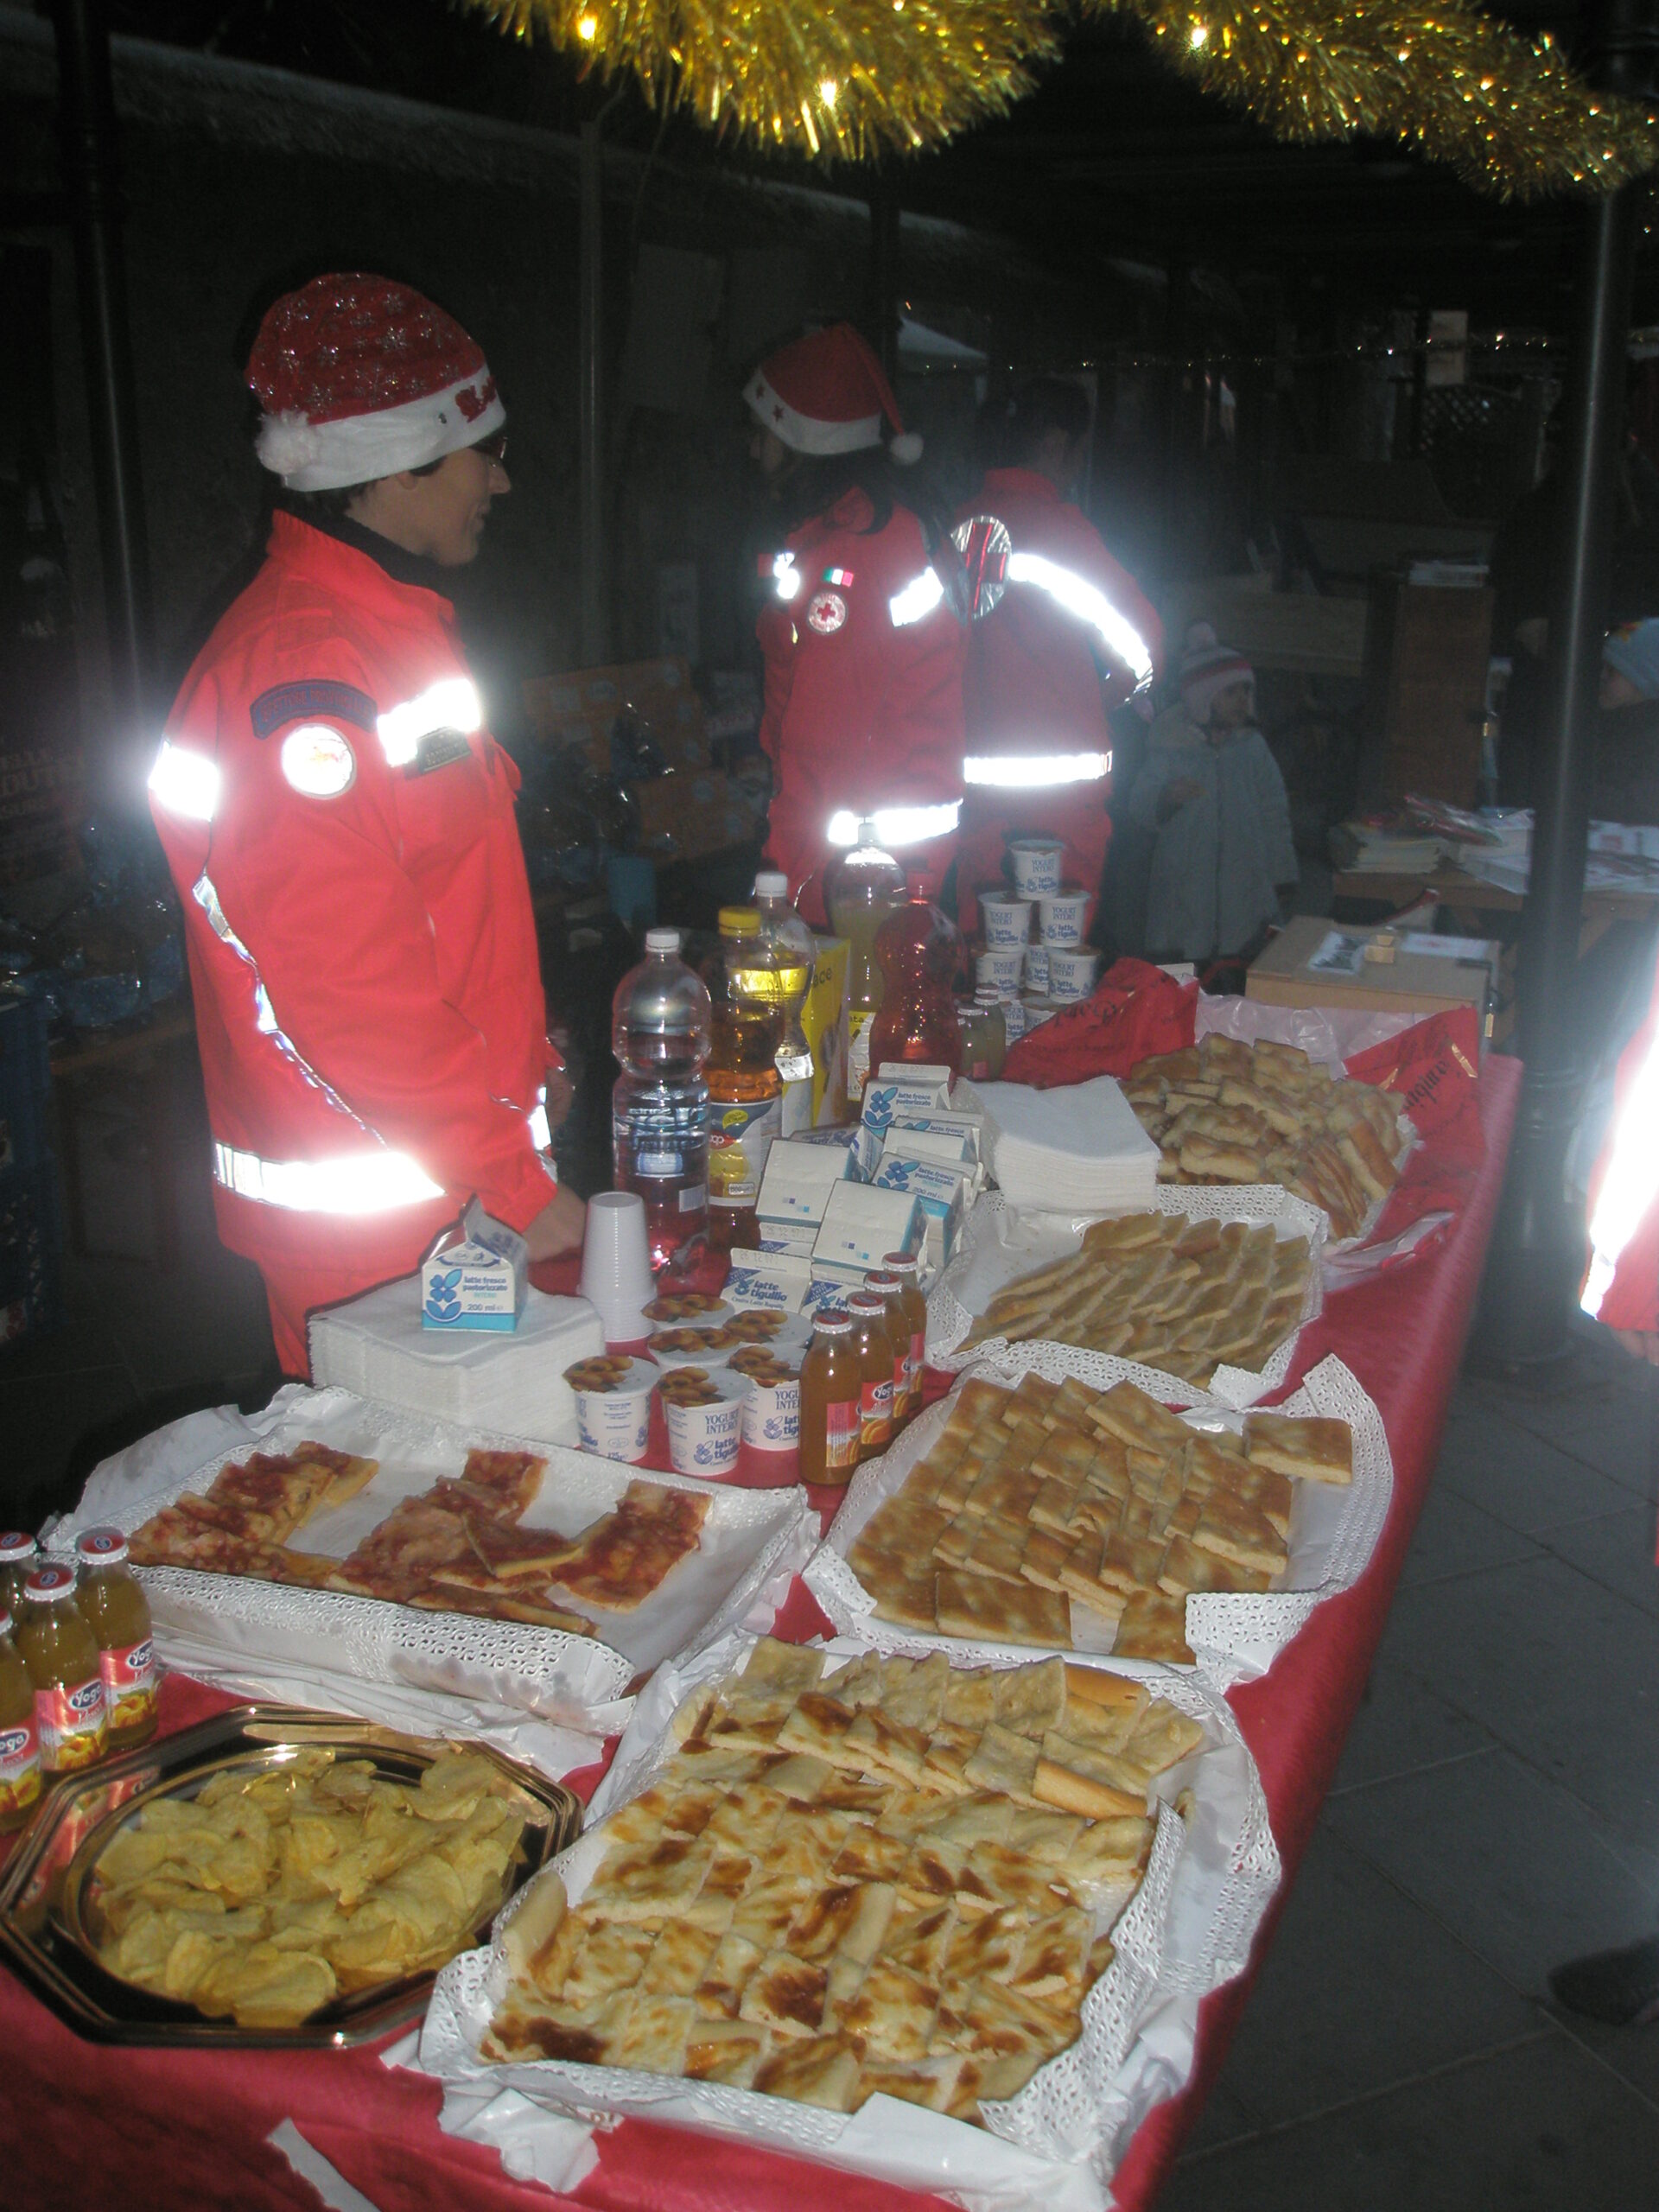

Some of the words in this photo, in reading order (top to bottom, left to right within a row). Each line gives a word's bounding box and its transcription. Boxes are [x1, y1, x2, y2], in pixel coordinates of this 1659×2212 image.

[896, 1098, 931, 1107] pastorizzato
[914, 1173, 954, 1186] pastorizzato
[918, 1166, 934, 1175] latte
[935, 1171, 955, 1181] fresco
[753, 1281, 779, 1290] latte
[750, 1288, 788, 1301] tigullio
